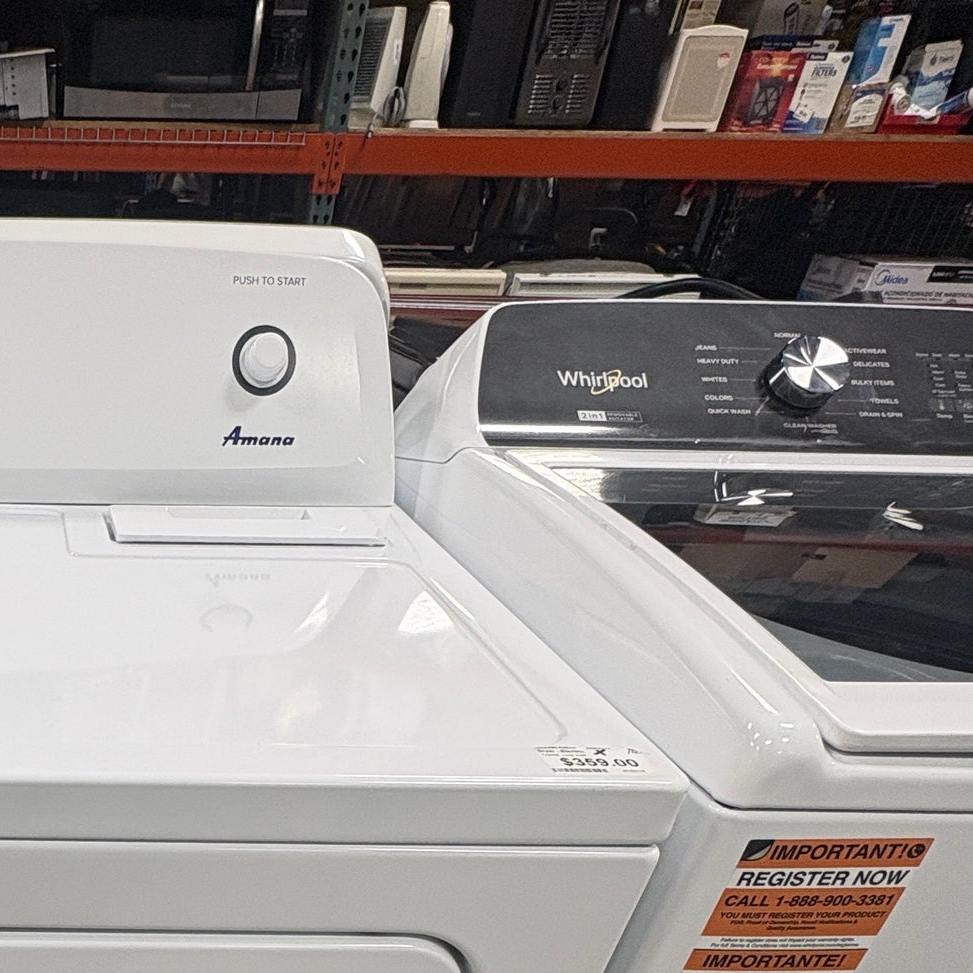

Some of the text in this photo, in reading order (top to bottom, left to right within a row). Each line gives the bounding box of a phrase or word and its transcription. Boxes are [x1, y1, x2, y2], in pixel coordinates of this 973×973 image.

[232, 276, 307, 286] PUSH TO START
[883, 274, 908, 285] Midea
[556, 369, 648, 394] Whirlpool
[222, 426, 296, 446] Amana
[560, 758, 640, 768] $359.00
[770, 843, 909, 860] IMPORTANT!
[736, 870, 910, 886] REGISTER NOW
[724, 894, 895, 906] CALL 1-888-900-3381
[702, 954, 847, 968] IMPORTANTE!
